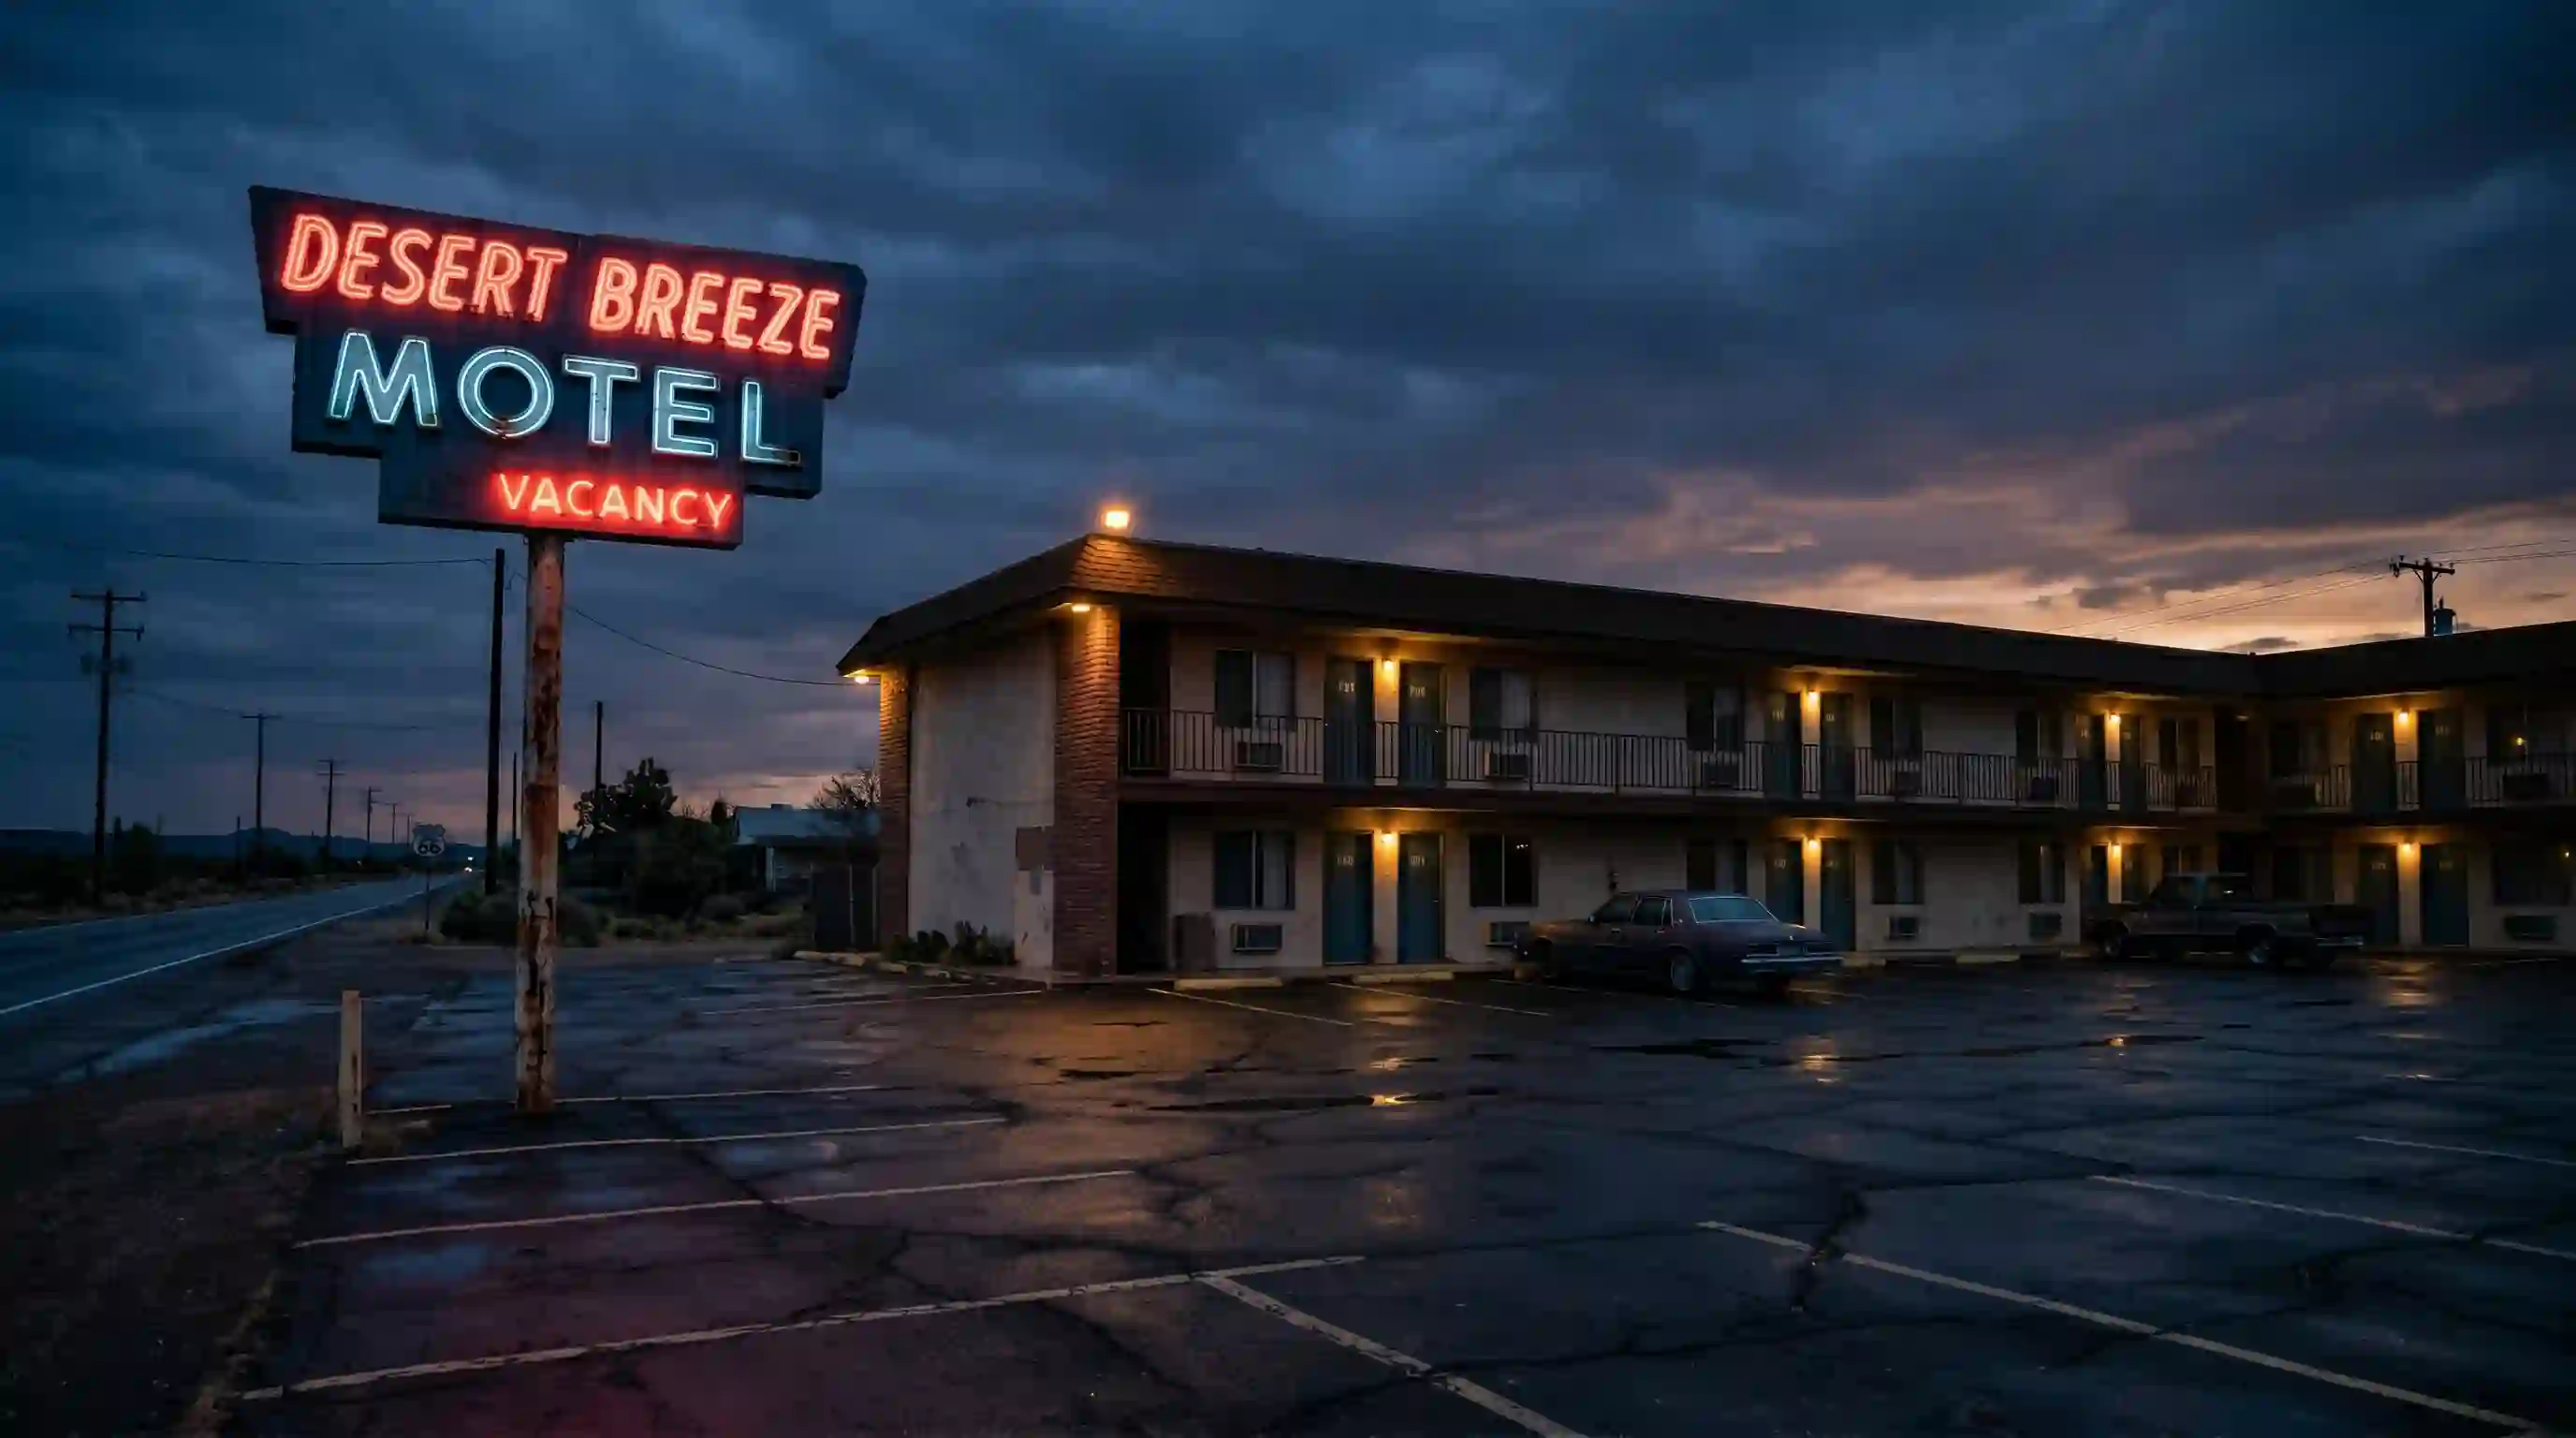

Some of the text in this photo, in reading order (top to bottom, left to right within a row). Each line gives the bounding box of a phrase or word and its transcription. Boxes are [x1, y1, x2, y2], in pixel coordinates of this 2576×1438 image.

[281, 213, 841, 360] DESERT BREEZE
[327, 330, 801, 466] MOTEL
[497, 472, 733, 530] VACANCY
[418, 840, 442, 855] 66
